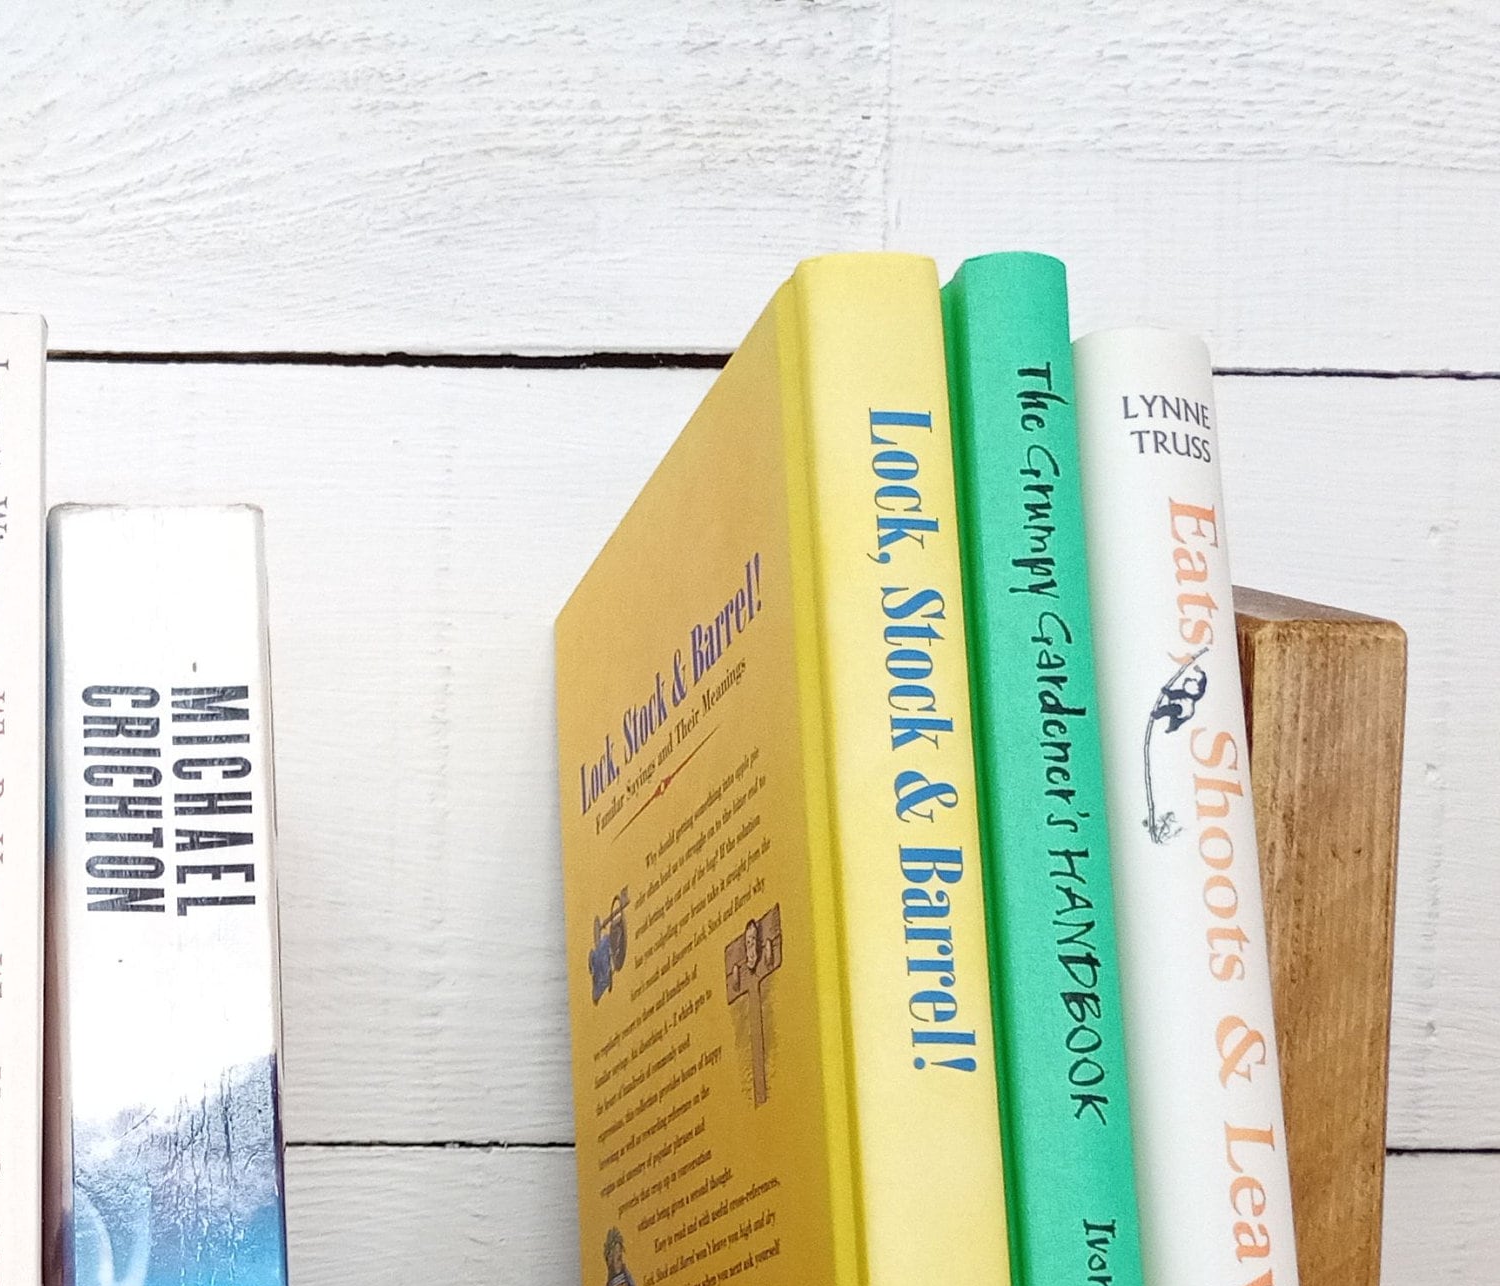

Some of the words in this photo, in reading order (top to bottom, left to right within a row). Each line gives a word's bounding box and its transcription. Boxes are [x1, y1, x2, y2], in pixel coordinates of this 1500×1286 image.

[1016, 361, 1069, 432] The
[1122, 394, 1211, 430] LYNNE
[1130, 430, 1212, 463] TRUSS
[867, 407, 940, 564] Lock,
[1008, 444, 1061, 600] Grumpy
[1167, 496, 1220, 666] Eats,
[579, 733, 621, 816] Lock,
[622, 671, 668, 765] Stock
[671, 648, 687, 708] &
[690, 552, 762, 686] Barrel!
[626, 762, 657, 801] Sayings
[657, 732, 673, 767] and
[674, 709, 700, 746] Their
[701, 658, 747, 718] Meanings
[880, 586, 954, 752] Stock
[1030, 611, 1090, 833] Gardener's
[82, 685, 165, 912] CRICHTON
[171, 685, 256, 916] MICHAEL
[893, 770, 959, 823] &
[1190, 727, 1251, 983] Shoots
[898, 844, 978, 1073] Barrel!
[1048, 847, 1110, 1127] HANDBOOK
[1214, 1014, 1268, 1089] &
[1082, 1218, 1116, 1284] Ivor
